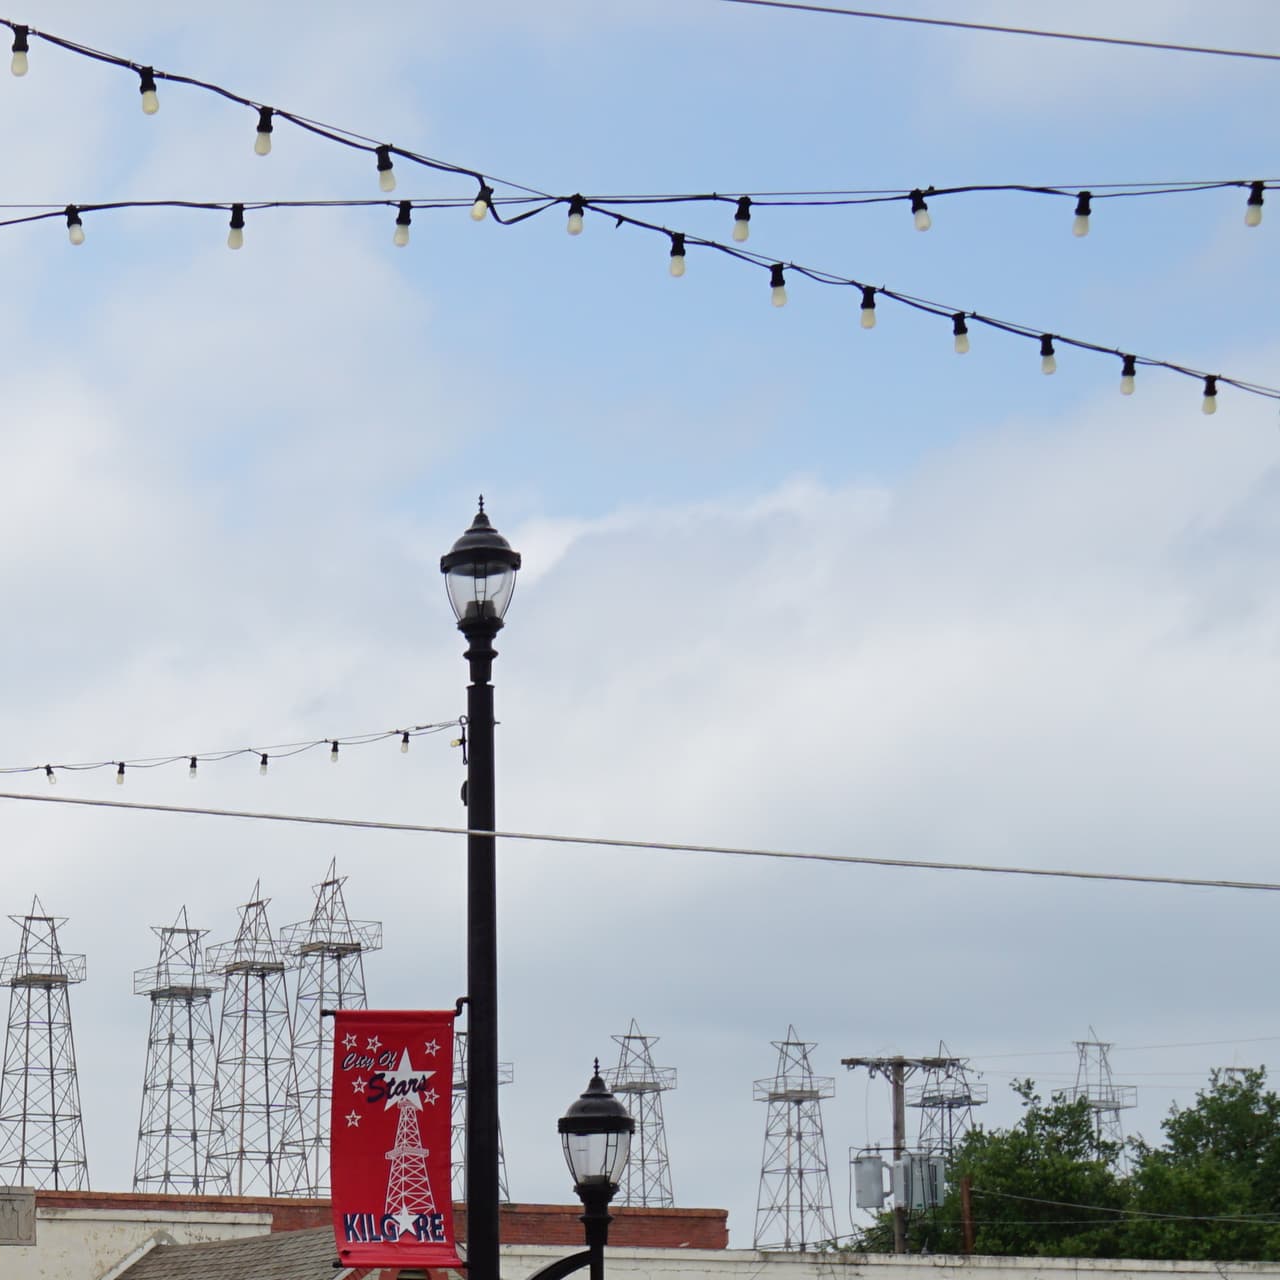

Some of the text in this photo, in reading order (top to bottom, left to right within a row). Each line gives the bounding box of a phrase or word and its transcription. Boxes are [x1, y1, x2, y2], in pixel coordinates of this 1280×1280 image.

[341, 1050, 398, 1072] City Of
[367, 1072, 428, 1103] Stars
